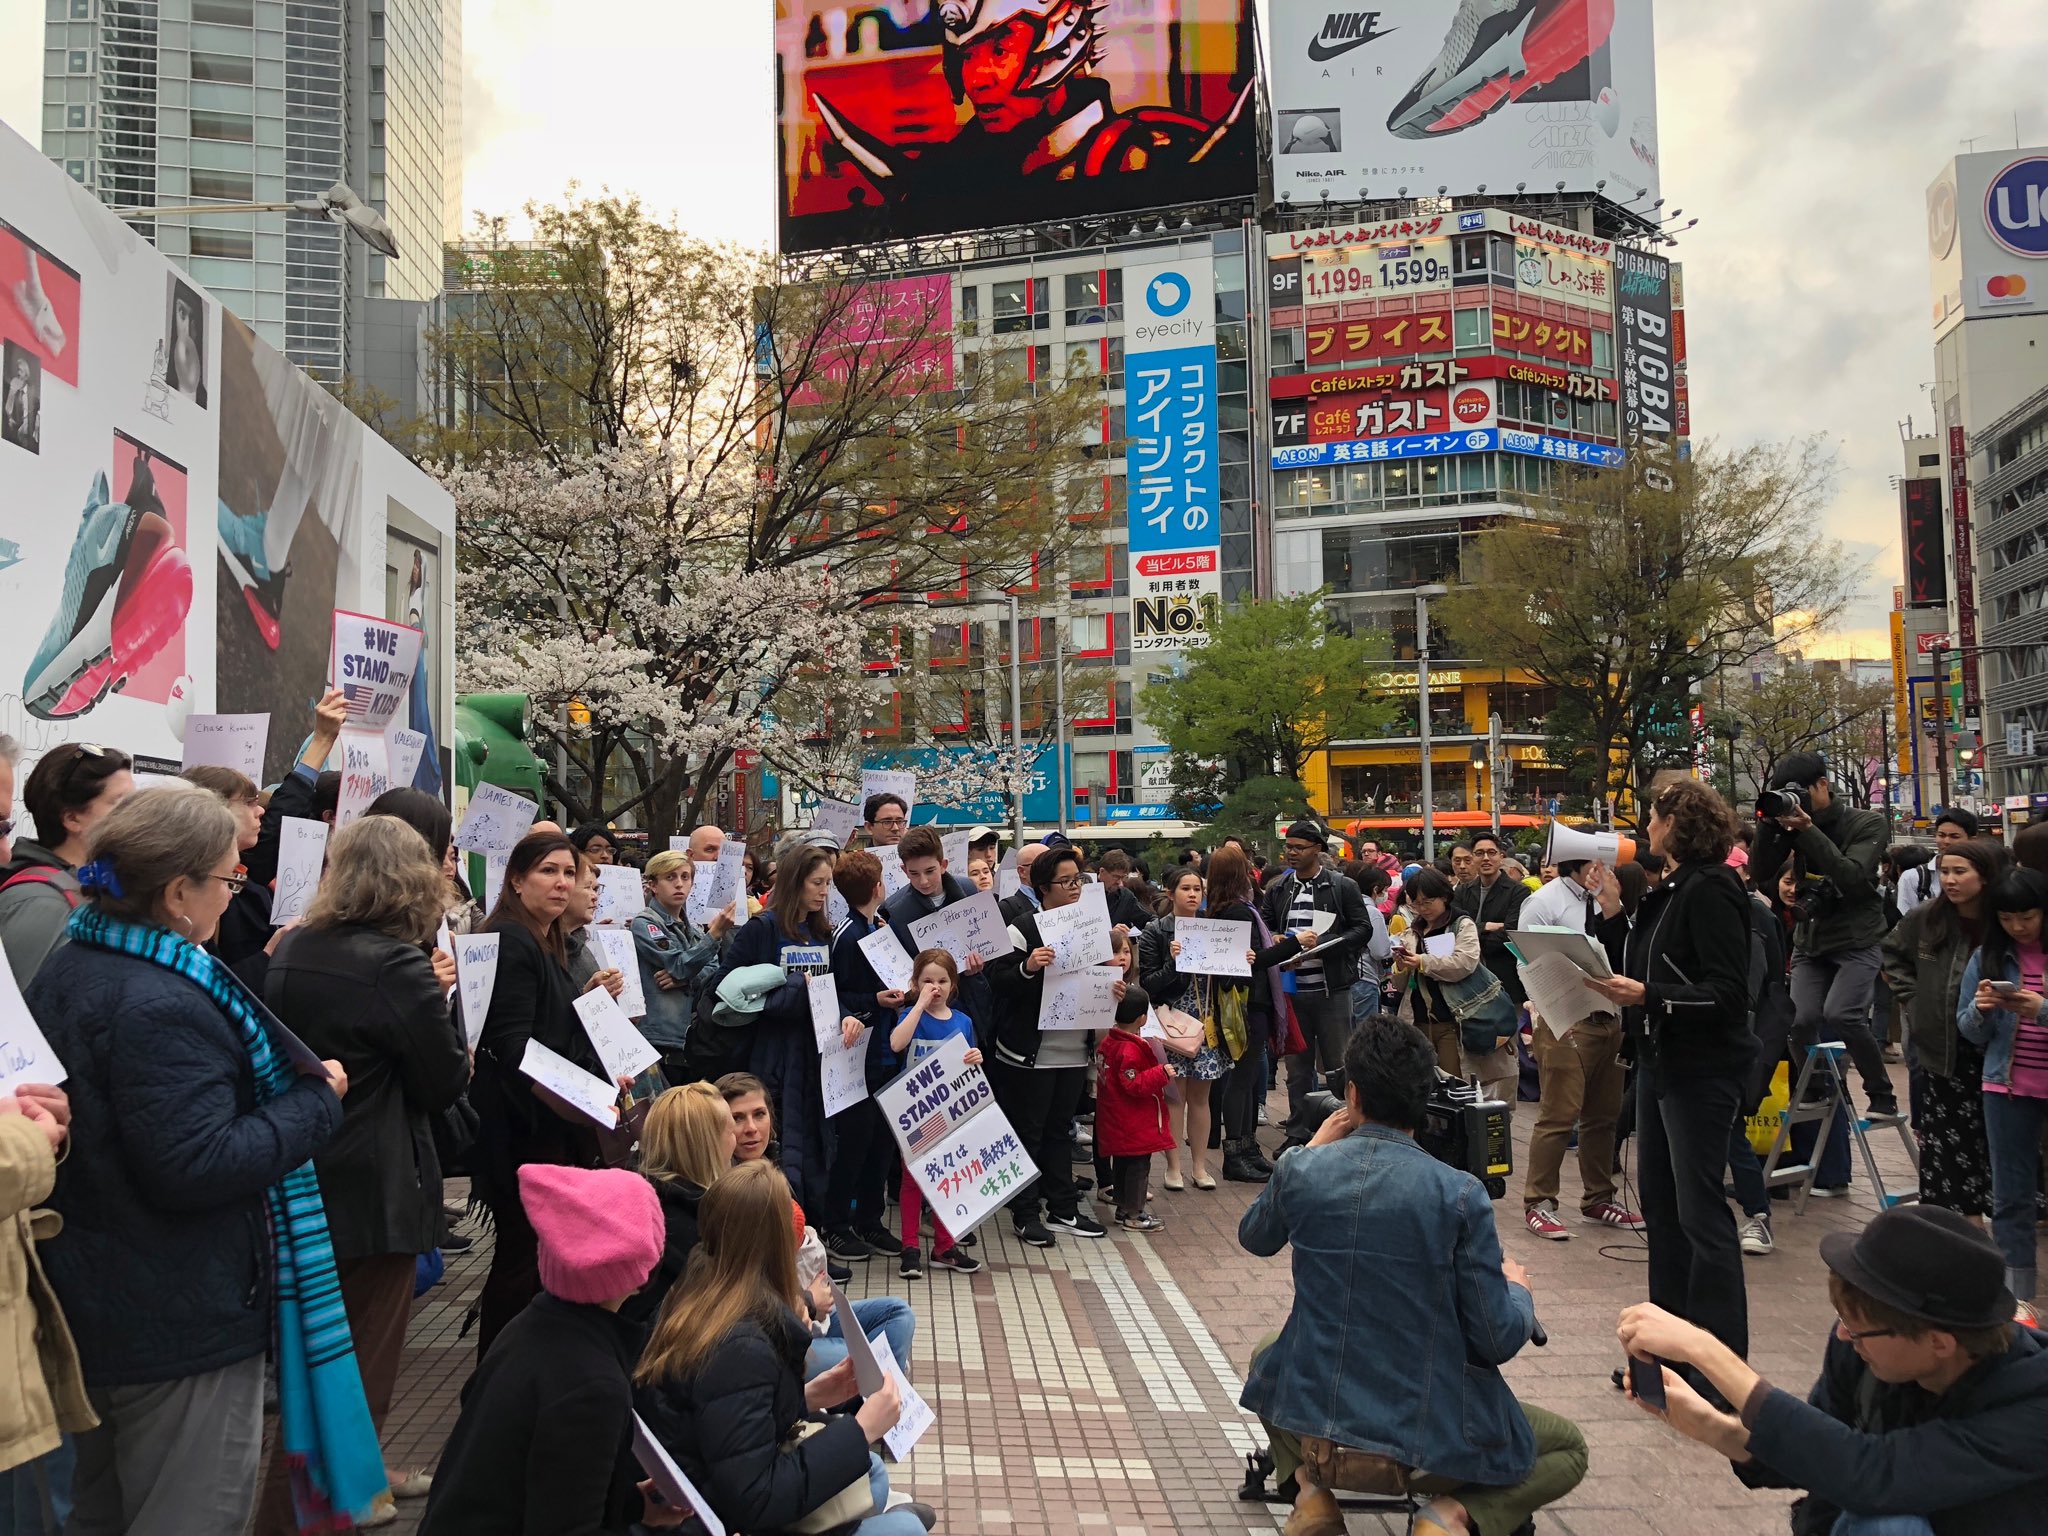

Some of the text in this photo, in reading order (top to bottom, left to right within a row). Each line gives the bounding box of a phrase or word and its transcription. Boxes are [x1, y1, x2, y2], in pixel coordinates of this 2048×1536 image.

[1320, 12, 1381, 39] NIKE
[1296, 170, 1322, 178] Nike,
[1290, 217, 1443, 249] しゃぶしゃぶバイキング
[1461, 215, 1482, 226] 寿司
[1508, 216, 1611, 256] しゃぶしゃぶバイキング
[1548, 259, 1606, 296] しゃぶ葉
[1616, 251, 1667, 281] BIGBANG
[1272, 272, 1298, 291] 9F
[1135, 319, 1203, 342] eyecity
[1308, 316, 1449, 356] プライス
[1493, 313, 1588, 355] コンタクト
[1400, 361, 1469, 390] ガスト
[1568, 372, 1611, 401] ガスト
[1313, 409, 1351, 426] Café
[1356, 400, 1442, 437] ガスト
[1458, 404, 1487, 415] ガスト
[1274, 414, 1306, 436] 7F
[1315, 425, 1351, 436] レストラン
[1136, 368, 1174, 534] アイシティ
[1181, 364, 1209, 531] コンタクトの
[1333, 436, 1460, 462] 英会話イーオン
[1468, 433, 1487, 447] 6F
[1506, 433, 1535, 450] AEON
[1542, 438, 1623, 465] 英会話イーオン
[1278, 448, 1321, 464] AEON
[1146, 555, 1210, 573] 当ビル5階
[1149, 579, 1200, 592] 利用者数
[364, 627, 399, 656] #WE
[343, 653, 410, 689] STAND WITH
[370, 692, 400, 716] KIDS
[195, 723, 224, 733] Chase
[477, 788, 513, 807] JAMES
[916, 922, 938, 939] Erin
[1038, 914, 1056, 929] Ross
[1175, 919, 1210, 933] Christine
[786, 951, 824, 965] MARCH
[1071, 950, 1102, 969] VA Tech
[906, 1059, 945, 1097] #WE
[898, 1064, 981, 1131] STAND WITH
[948, 1081, 990, 1121] KIDS
[924, 1143, 969, 1183] 我々は
[936, 1133, 1018, 1199] アメリカ高校生
[979, 1153, 1024, 1197] 味方だ
